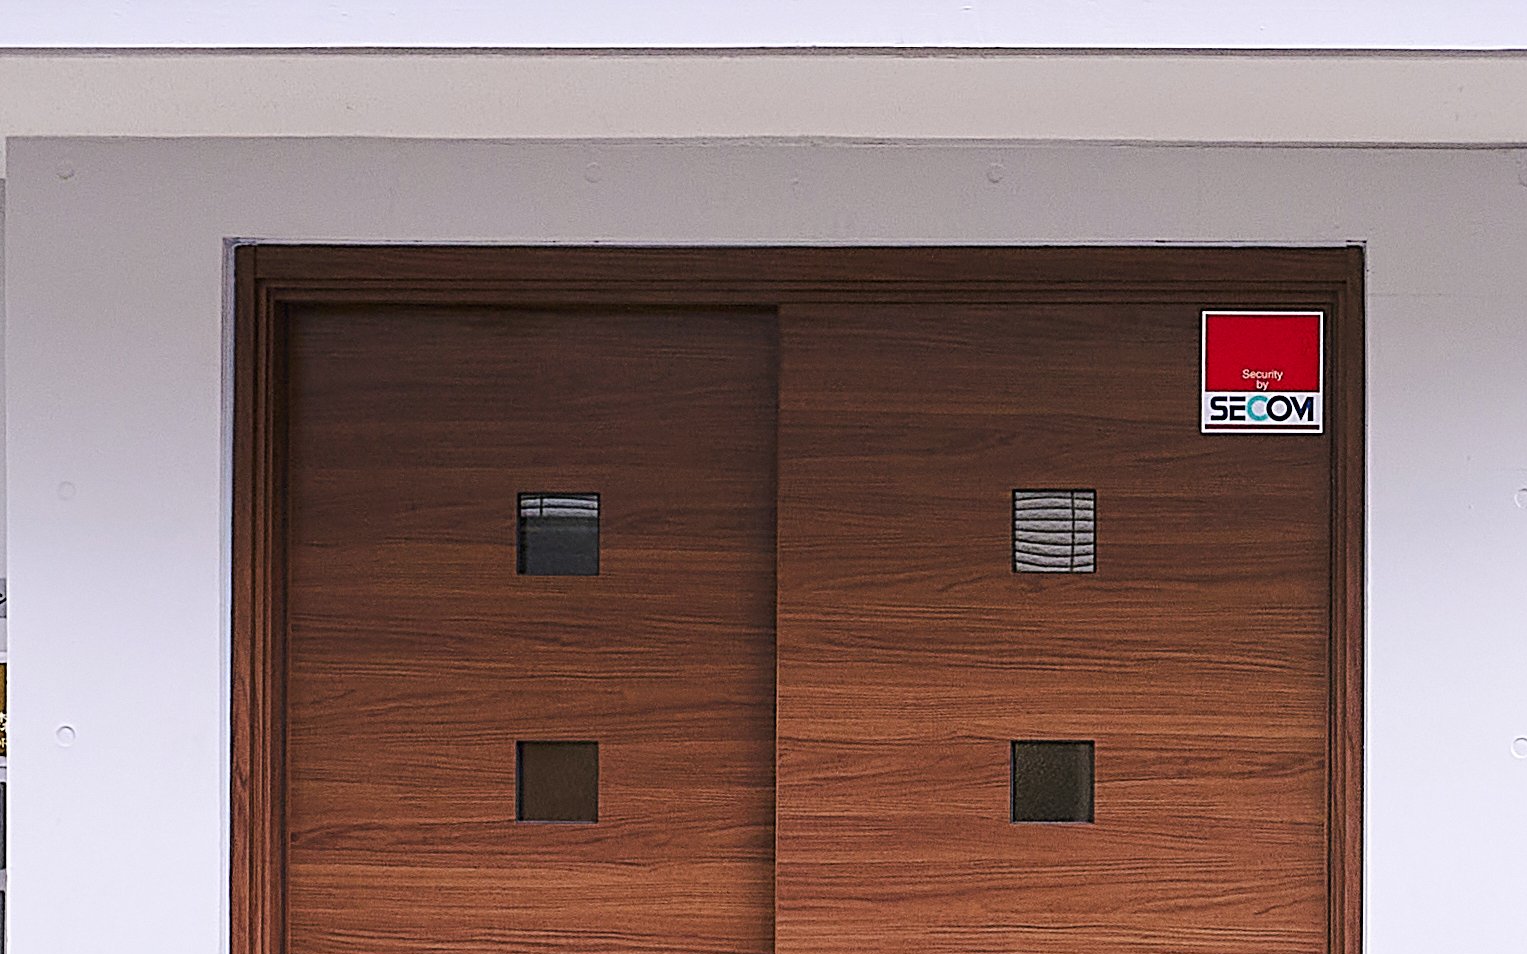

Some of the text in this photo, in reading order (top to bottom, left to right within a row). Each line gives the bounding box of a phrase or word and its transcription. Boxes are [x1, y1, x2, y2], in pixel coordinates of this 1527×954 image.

[1241, 368, 1284, 382] Security
[1255, 379, 1270, 391] by
[1209, 394, 1315, 422] SECOM
